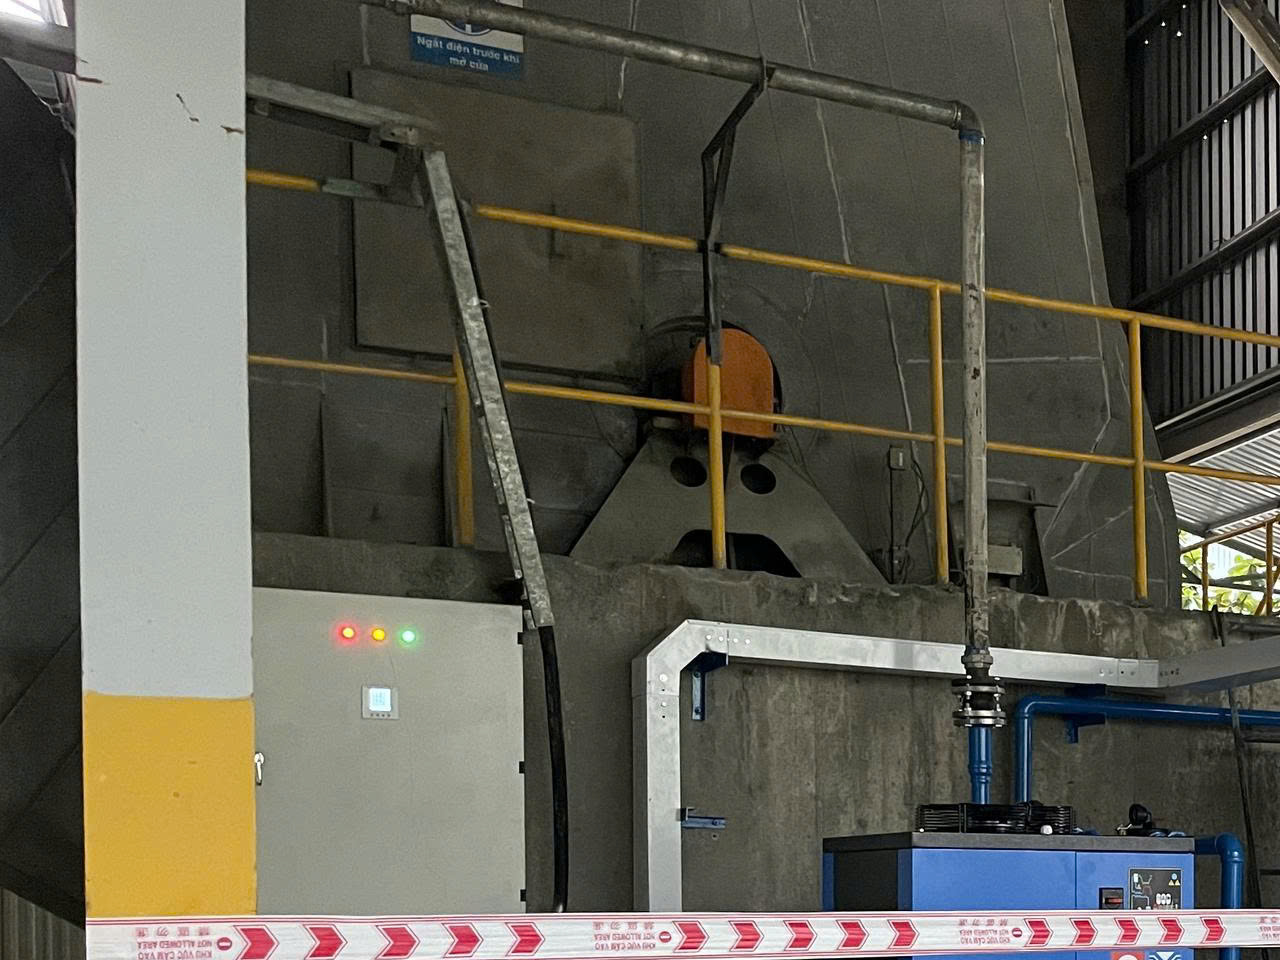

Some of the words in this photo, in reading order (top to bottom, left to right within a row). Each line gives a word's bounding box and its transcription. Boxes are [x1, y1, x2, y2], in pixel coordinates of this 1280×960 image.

[503, 53, 520, 64] khi
[137, 941, 158, 949] AREA
[160, 940, 196, 949] ALLOWED
